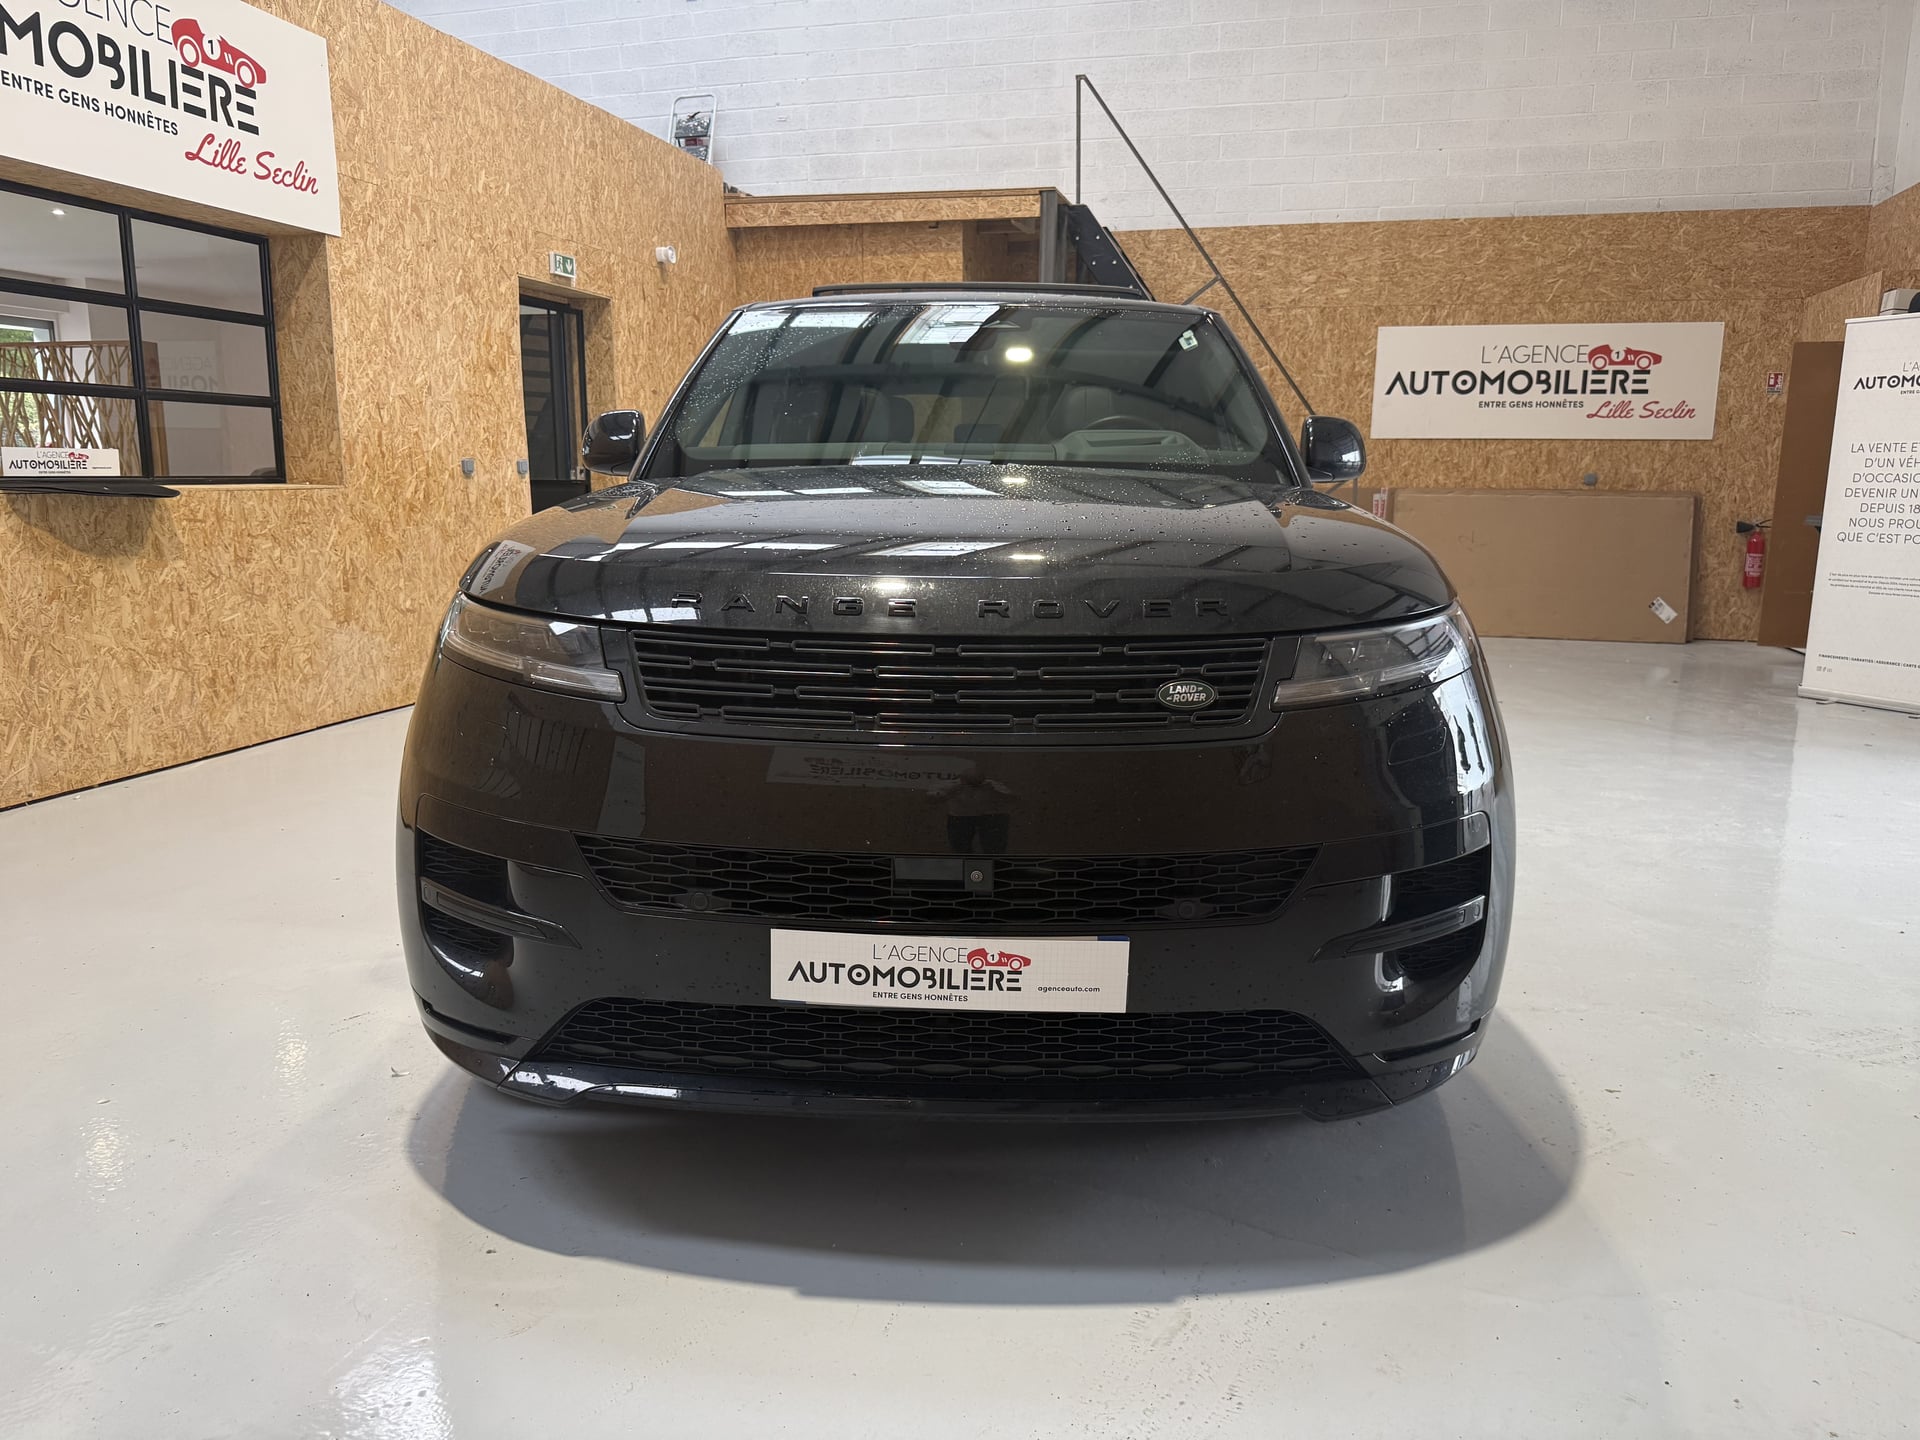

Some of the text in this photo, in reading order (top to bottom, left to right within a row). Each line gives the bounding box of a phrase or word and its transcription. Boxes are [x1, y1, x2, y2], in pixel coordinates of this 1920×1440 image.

[1, 70, 179, 136] ENTRE GENS HONNÊTES
[184, 132, 319, 194] Lille Seclin
[1481, 345, 1590, 364] L'AGENCE
[1478, 398, 1584, 409] ENTRE GENS HONNÊTES
[1586, 400, 1696, 419] Lille Seclin
[1850, 443, 1865, 453] LA
[1868, 442, 1907, 453] VENTE
[1864, 458, 1895, 468] D'UN
[1844, 488, 1919, 498] DEVENIR UN
[1860, 503, 1905, 513] DEPUIS
[1848, 518, 1884, 528] NOUS
[1837, 532, 1863, 543] QUE
[1866, 533, 1901, 544] C'EST
[671, 591, 1228, 618] RANGE ROVER
[1169, 685, 1197, 694] LAND
[1172, 692, 1207, 702] ROVER
[873, 944, 968, 963] L'AGENCE
[1037, 985, 1101, 993] agenceauto.com
[872, 991, 968, 1002] ENTRE GENS HONNÊTES
